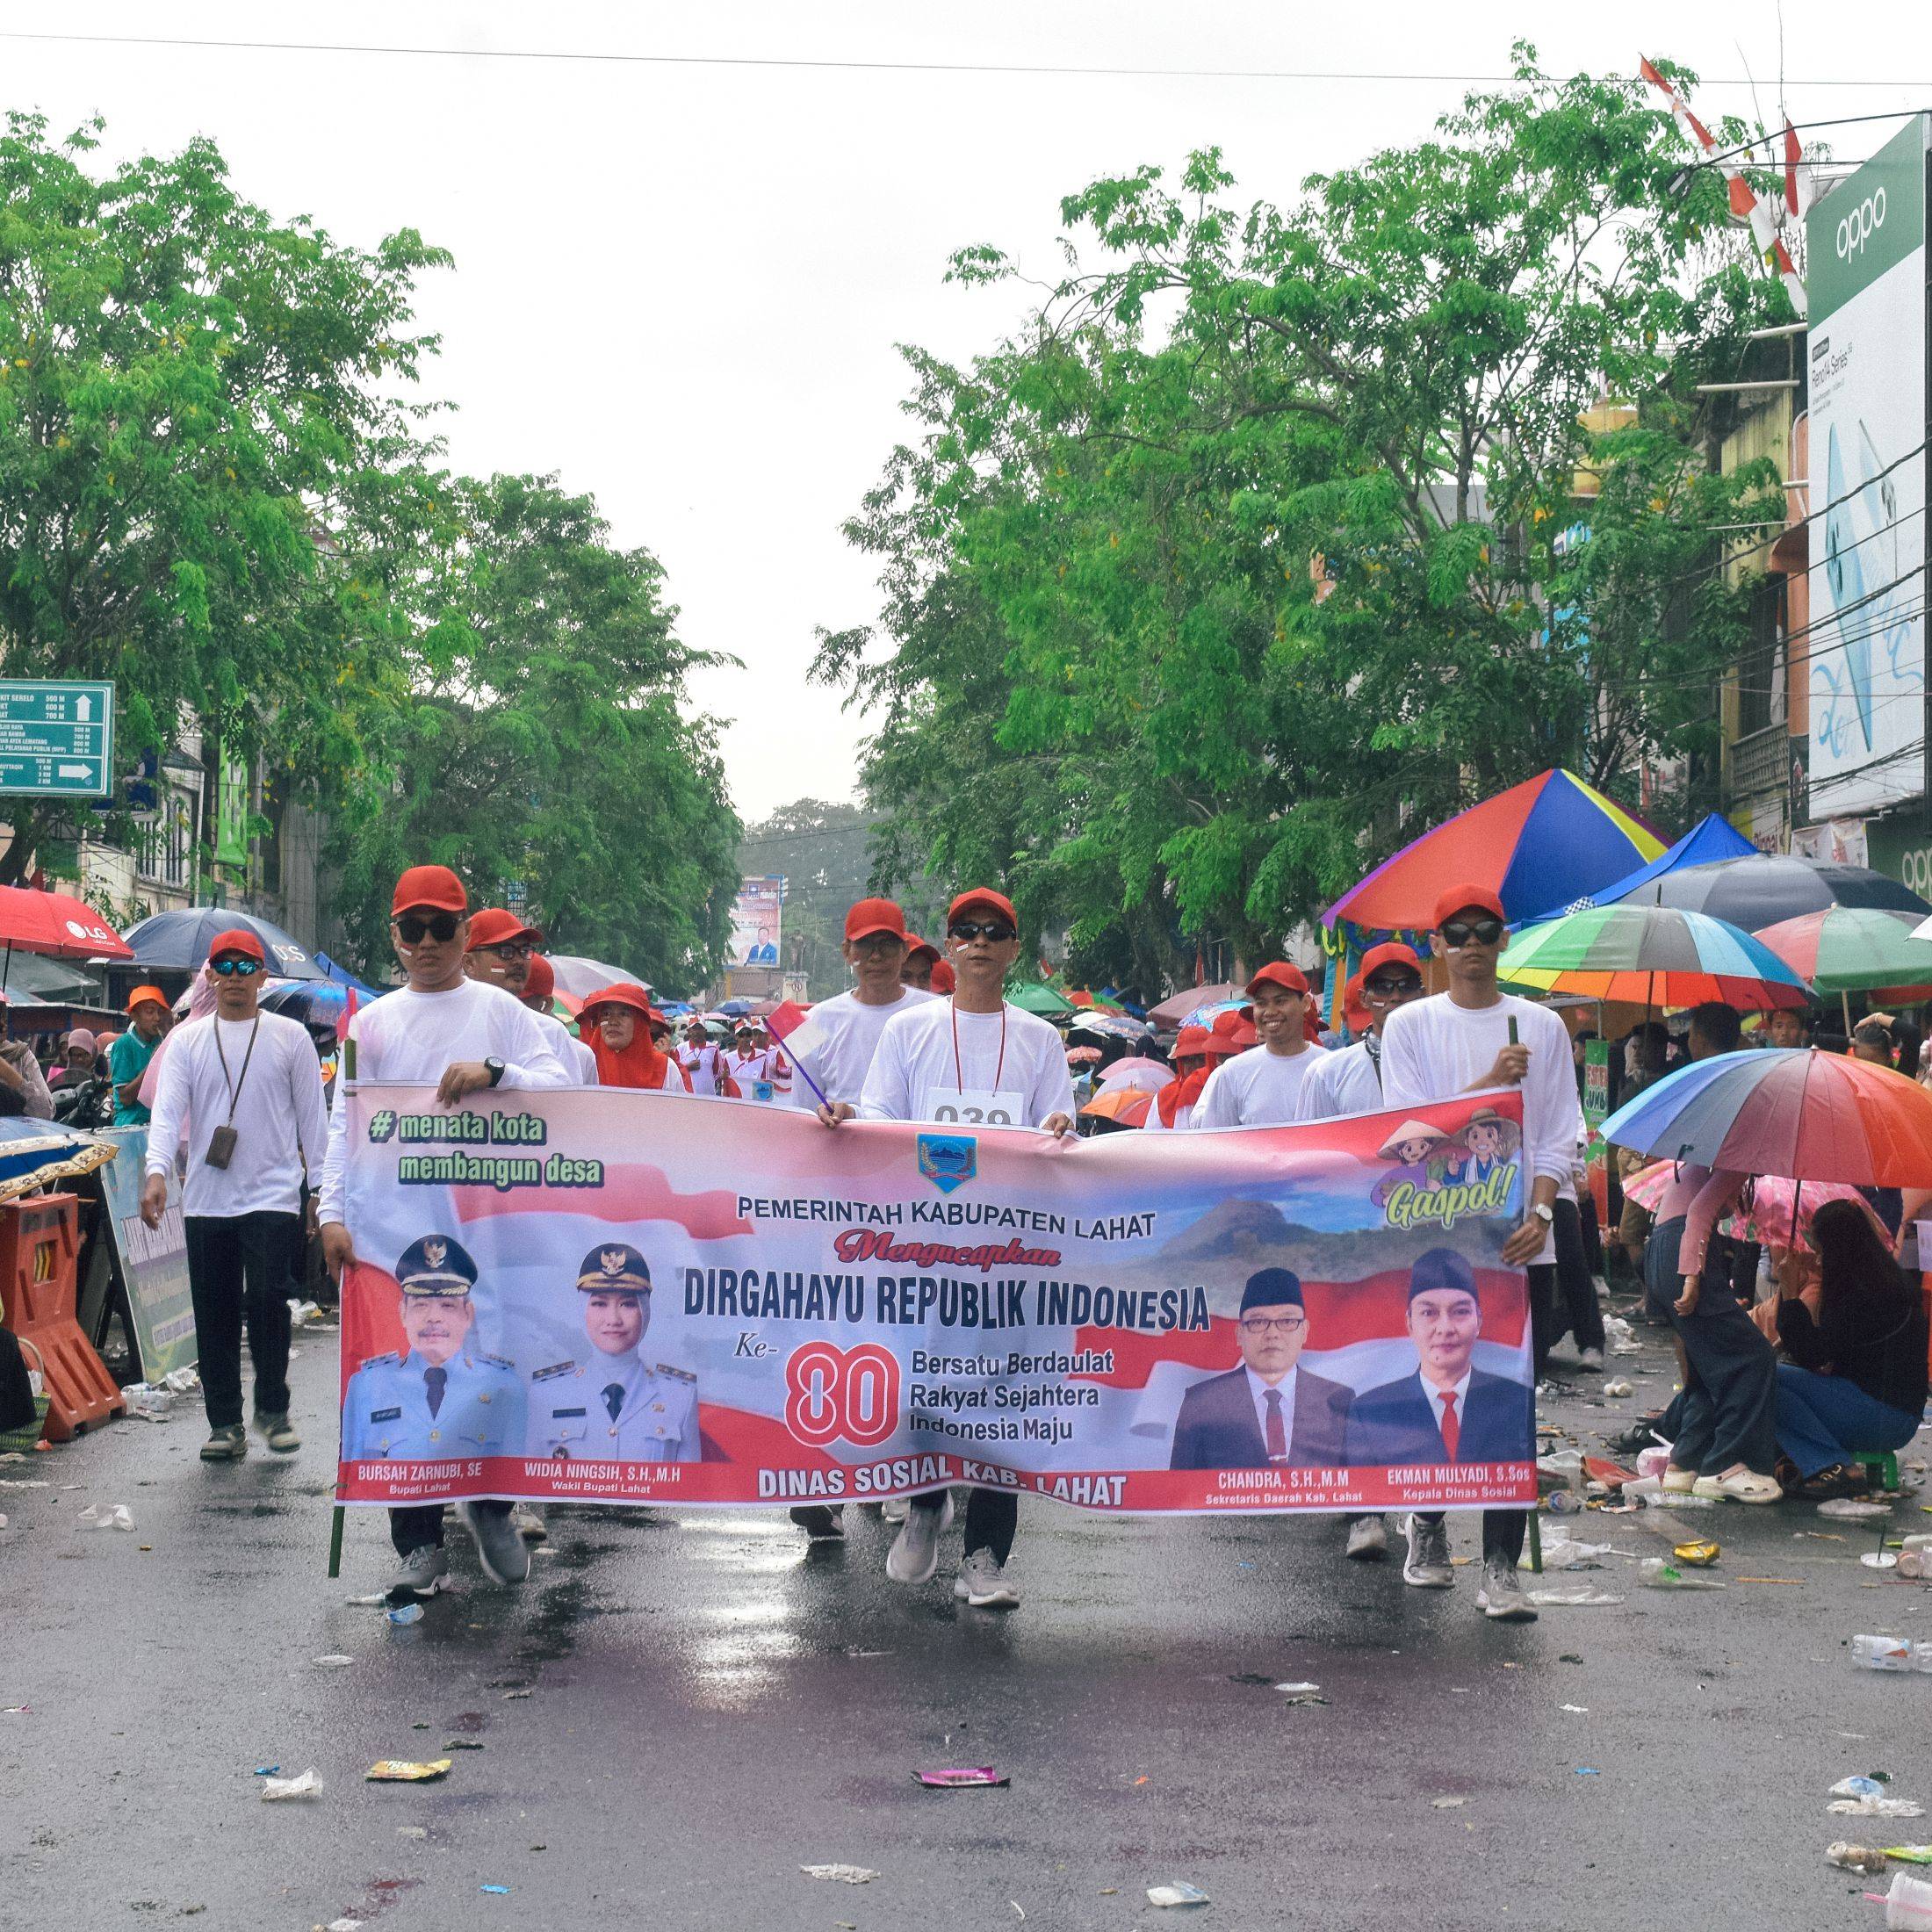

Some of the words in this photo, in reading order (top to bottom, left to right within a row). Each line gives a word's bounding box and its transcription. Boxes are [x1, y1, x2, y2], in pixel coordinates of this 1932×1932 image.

[84, 926, 108, 940] LG
[490, 1111, 547, 1146] kota
[398, 1151, 542, 1192] membangun
[544, 1153, 605, 1188] desa
[1386, 1164, 1518, 1229] Gaspol!
[738, 1196, 904, 1225] PEMERINTAH
[911, 1200, 1066, 1235] KABUPATEN
[1075, 1213, 1156, 1241] LAHAT
[833, 1228, 1062, 1272] Mengucapkan
[684, 1268, 864, 1323] DIRGAHAYU
[877, 1275, 1027, 1330] REPUBLIK
[1037, 1280, 1211, 1331] INDONESIA
[912, 1350, 1000, 1376] Bersatu
[1006, 1349, 1114, 1375] Berdaulat
[734, 1332, 777, 1359] Ke-
[784, 1340, 901, 1449] 80
[910, 1384, 988, 1412] Rakyat
[993, 1385, 1099, 1412] Sejahtera
[910, 1414, 1020, 1441] Indonesia
[1023, 1417, 1073, 1445] Maju
[358, 1465, 407, 1481] BURSAH
[410, 1462, 464, 1481] ZARNUBI,
[467, 1462, 482, 1477] SE
[524, 1462, 563, 1478] WIDIA
[566, 1463, 623, 1481] NINGSIH,
[758, 1467, 846, 1499] DINAS
[854, 1454, 953, 1492] SOSIAL
[962, 1460, 1027, 1489] KAB.
[1036, 1474, 1127, 1507] LAHAT
[1218, 1470, 1287, 1490] CHANDRA,
[1388, 1468, 1431, 1486] EKMAN
[1434, 1466, 1492, 1485] MULYADI,
[389, 1483, 422, 1496] Bupati
[424, 1481, 451, 1494] Lahat
[551, 1480, 580, 1491] Wakil
[583, 1481, 618, 1494] Bupati
[621, 1482, 651, 1494] Lahat
[1206, 1494, 1260, 1506] Sekretaris
[1264, 1492, 1302, 1504] Daerah
[1332, 1491, 1363, 1503] Lahat
[1403, 1488, 1442, 1502] Kepala
[1445, 1487, 1479, 1499] Dinas
[1481, 1486, 1517, 1498] Sosial
